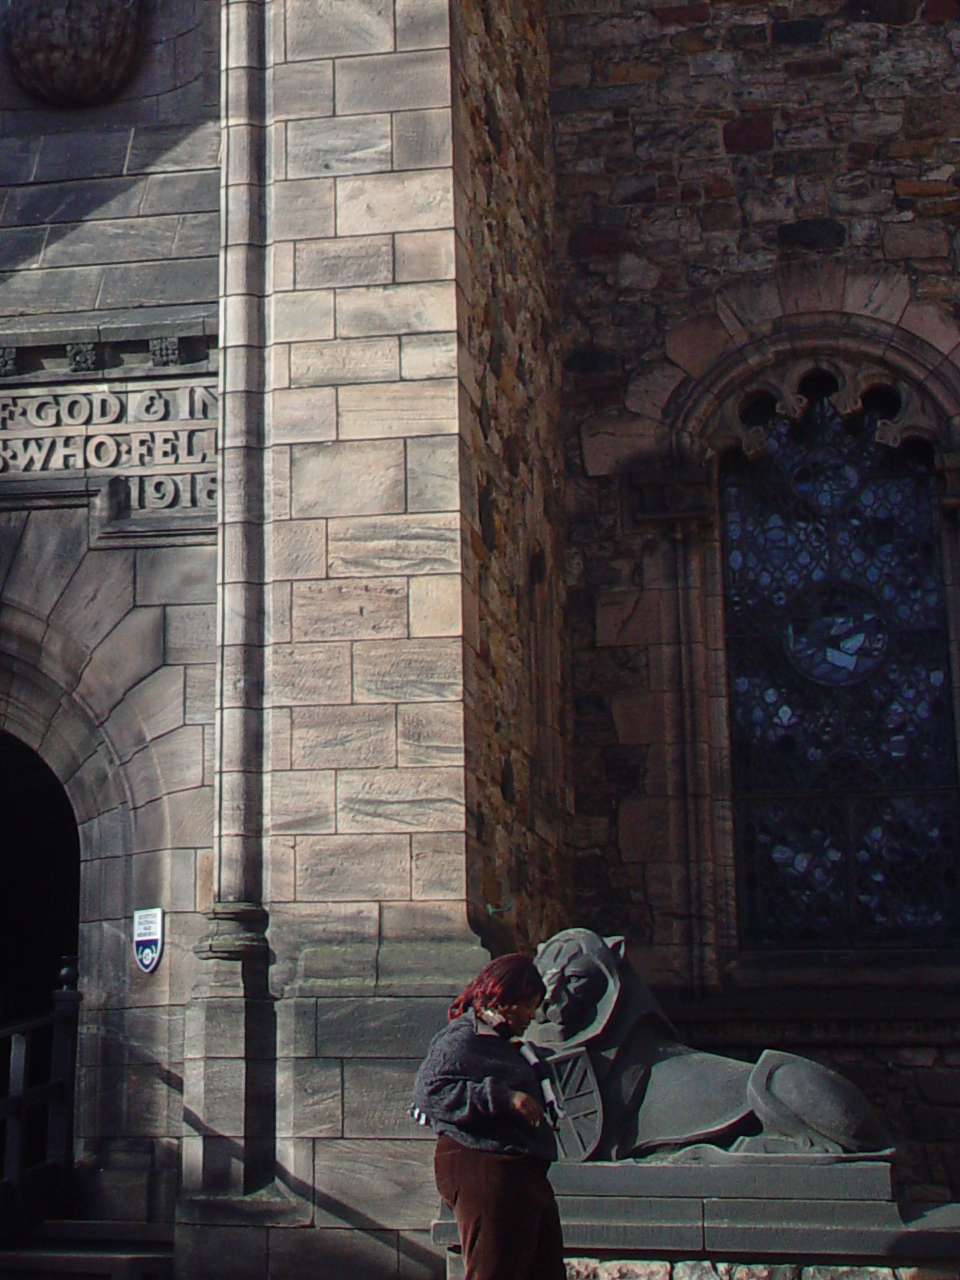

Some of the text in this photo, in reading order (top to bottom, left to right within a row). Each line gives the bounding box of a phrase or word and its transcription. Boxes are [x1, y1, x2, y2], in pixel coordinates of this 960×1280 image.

[26, 392, 121, 427] GOD
[136, 389, 166, 422] &
[17, 434, 118, 472] WHO
[130, 429, 217, 467] FELL
[128, 474, 218, 510] 1918
